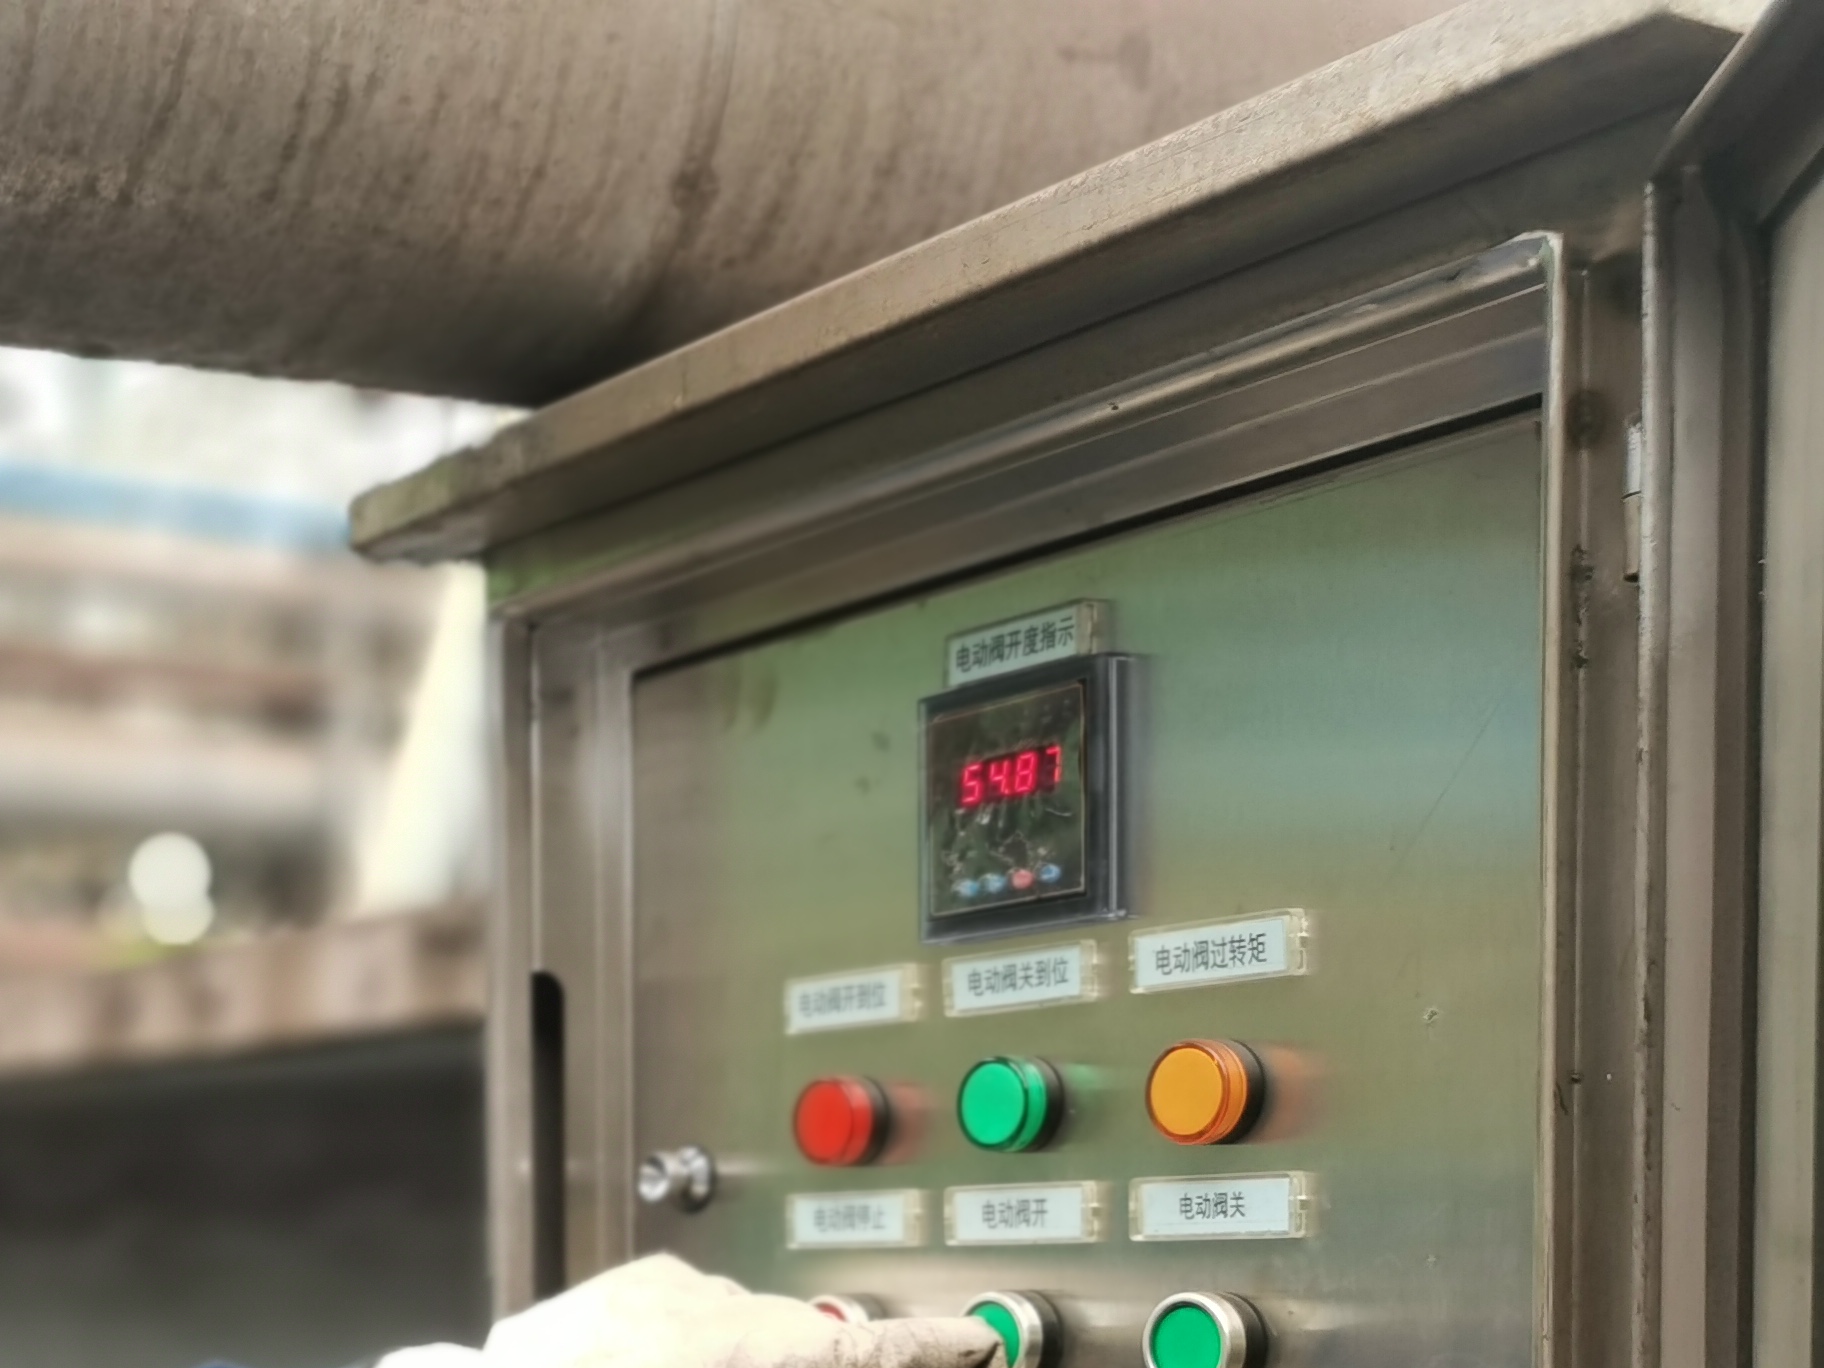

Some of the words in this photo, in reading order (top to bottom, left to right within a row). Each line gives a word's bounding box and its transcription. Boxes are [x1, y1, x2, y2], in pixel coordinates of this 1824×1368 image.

[954, 617, 1074, 673] 电动阀开度指示
[1153, 932, 1269, 976] 电动阀过转矩
[966, 955, 1068, 998] 电动阀关到位
[980, 1197, 1049, 1230] 电动阀开
[1178, 1191, 1247, 1221] 电动阀关
